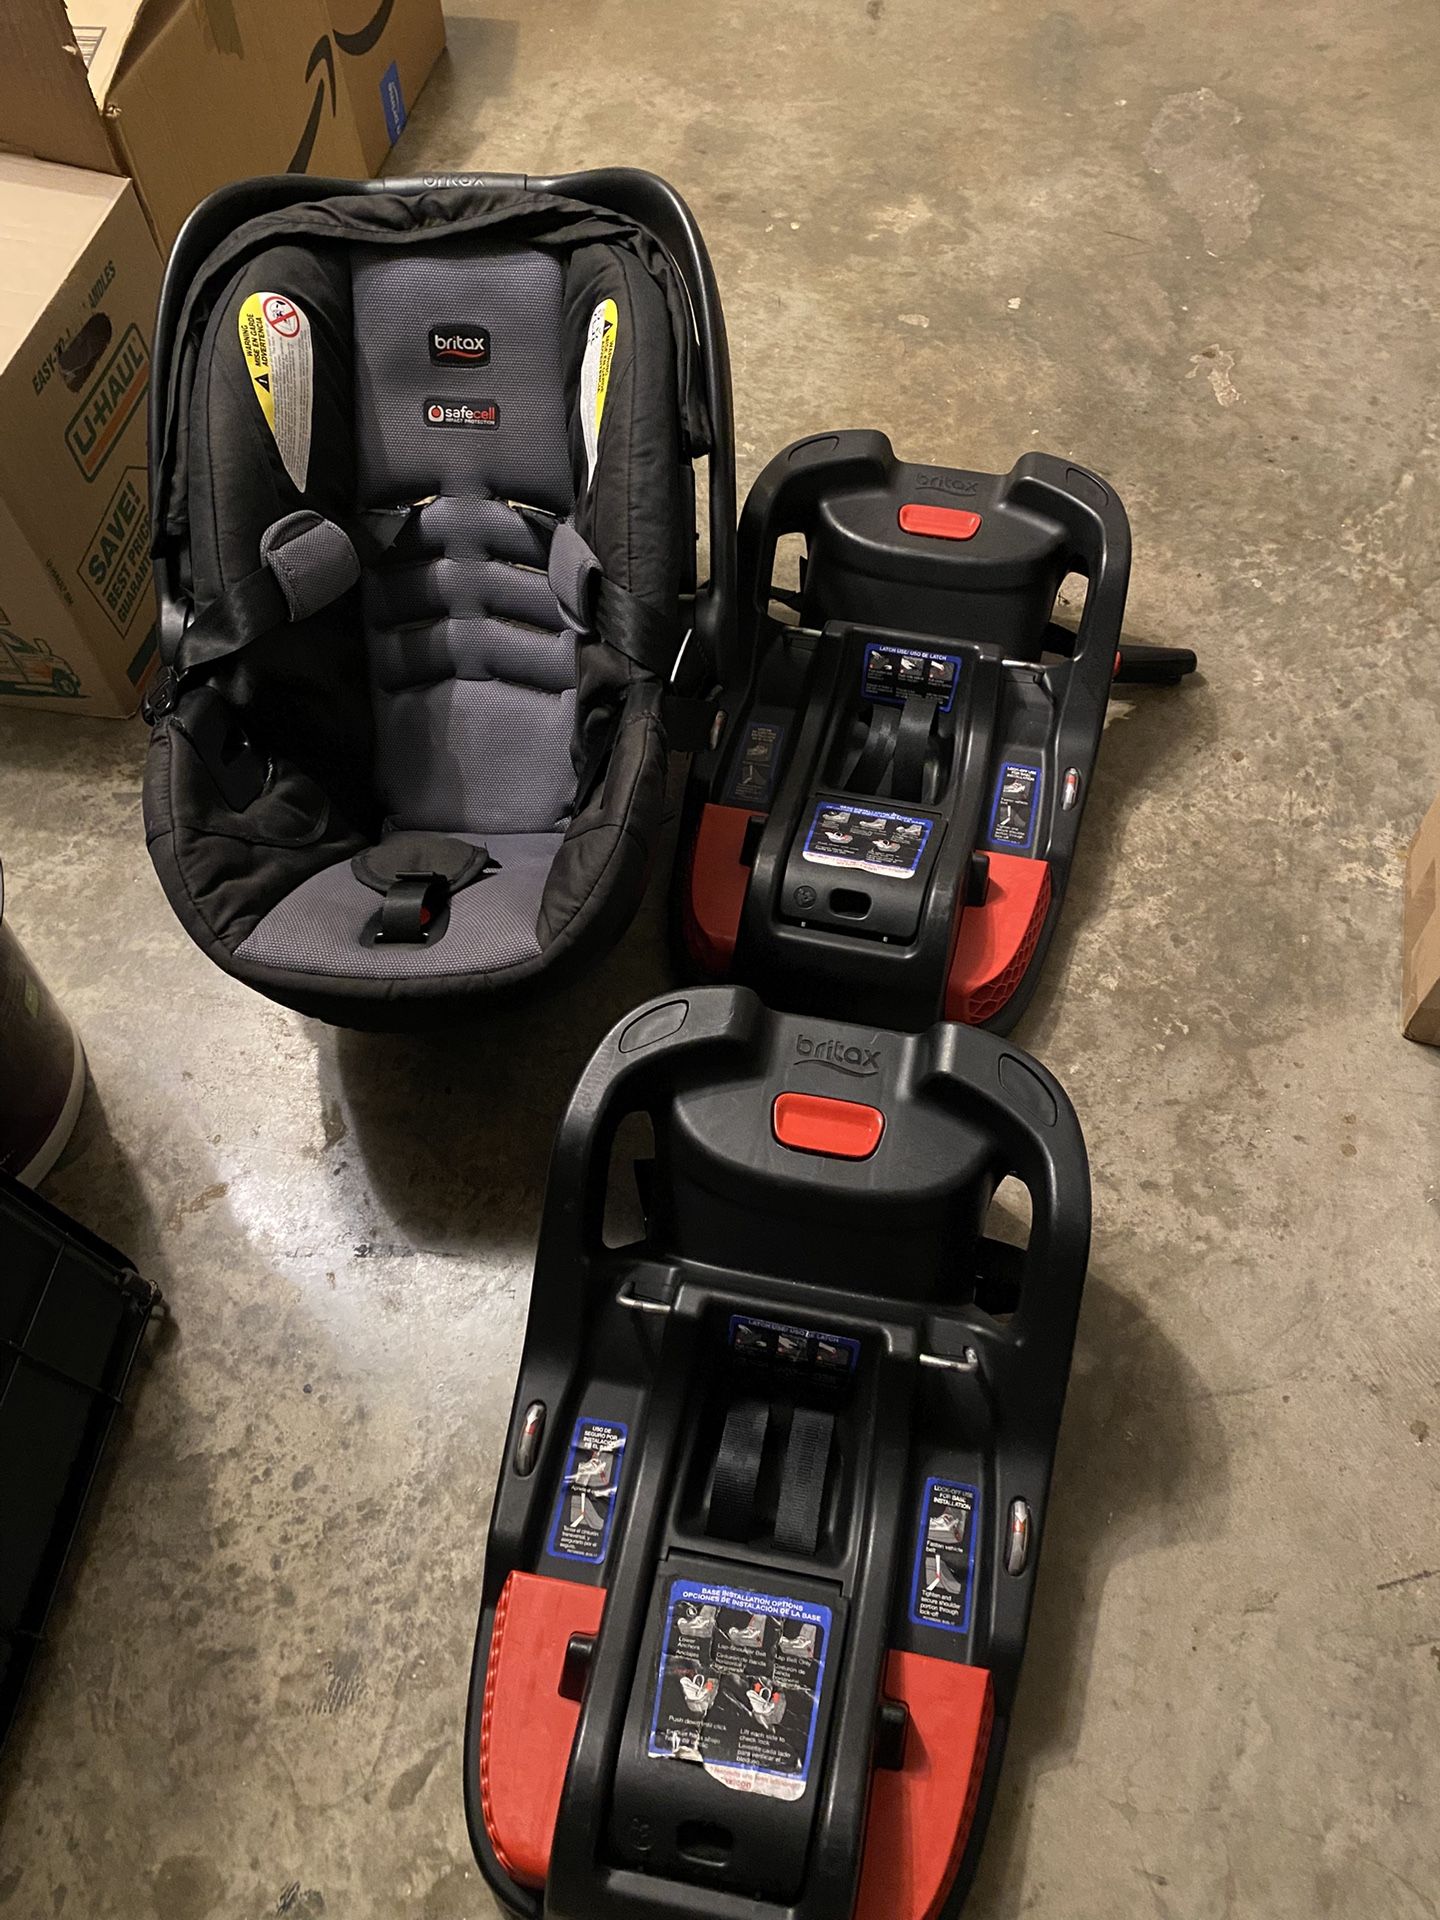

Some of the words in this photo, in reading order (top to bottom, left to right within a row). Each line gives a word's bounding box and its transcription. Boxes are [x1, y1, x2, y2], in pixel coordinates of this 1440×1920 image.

[241, 324, 254, 357] WARNING
[251, 337, 260, 348] EN
[255, 317, 269, 368] ADVERTENCIA
[434, 333, 485, 350] britax
[253, 348, 262, 367] MISE
[72, 343, 145, 456] U-HAUL
[445, 405, 495, 420] safecell
[916, 473, 979, 493] britax
[88, 480, 141, 586] SAVE!
[106, 560, 131, 611] BEST
[796, 1034, 881, 1069] britax
[682, 1590, 720, 1603] OPCIONES
[720, 1596, 731, 1605] DE
[790, 1609, 801, 1618] LA
[801, 1612, 822, 1623] BASE
[701, 1587, 721, 1598] BASE
[721, 1589, 771, 1606] INSTALLATION
[771, 1599, 804, 1612] OPTIONS
[678, 1636, 697, 1645] Lower
